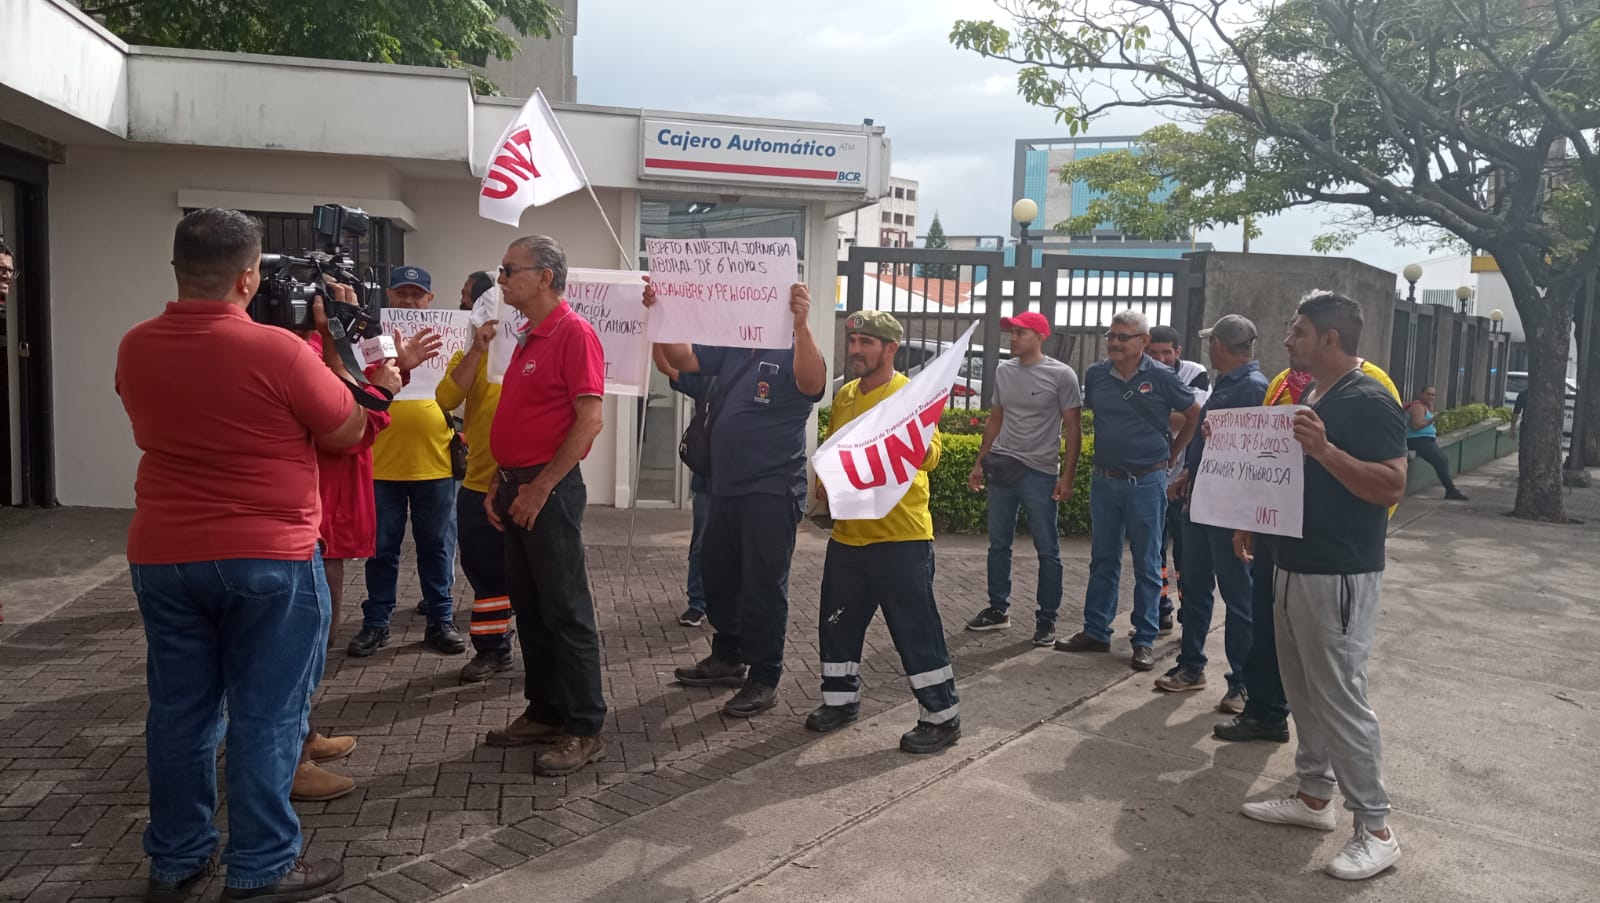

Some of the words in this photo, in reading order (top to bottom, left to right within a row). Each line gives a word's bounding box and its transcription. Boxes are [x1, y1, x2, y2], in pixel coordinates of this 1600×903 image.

[657, 128, 722, 151] Cajero
[727, 134, 836, 157] Automático
[839, 142, 856, 151] ATM
[481, 128, 541, 199] UNT
[838, 171, 861, 181] BCR
[685, 242, 693, 255] A
[693, 240, 739, 255] NUESTRA
[741, 241, 790, 256] JORNADA
[694, 258, 712, 275] DE
[717, 257, 725, 273] 6
[707, 284, 713, 301] Y
[739, 326, 763, 342] UNT
[839, 394, 949, 490] UNT
[1255, 506, 1279, 528] UNT
